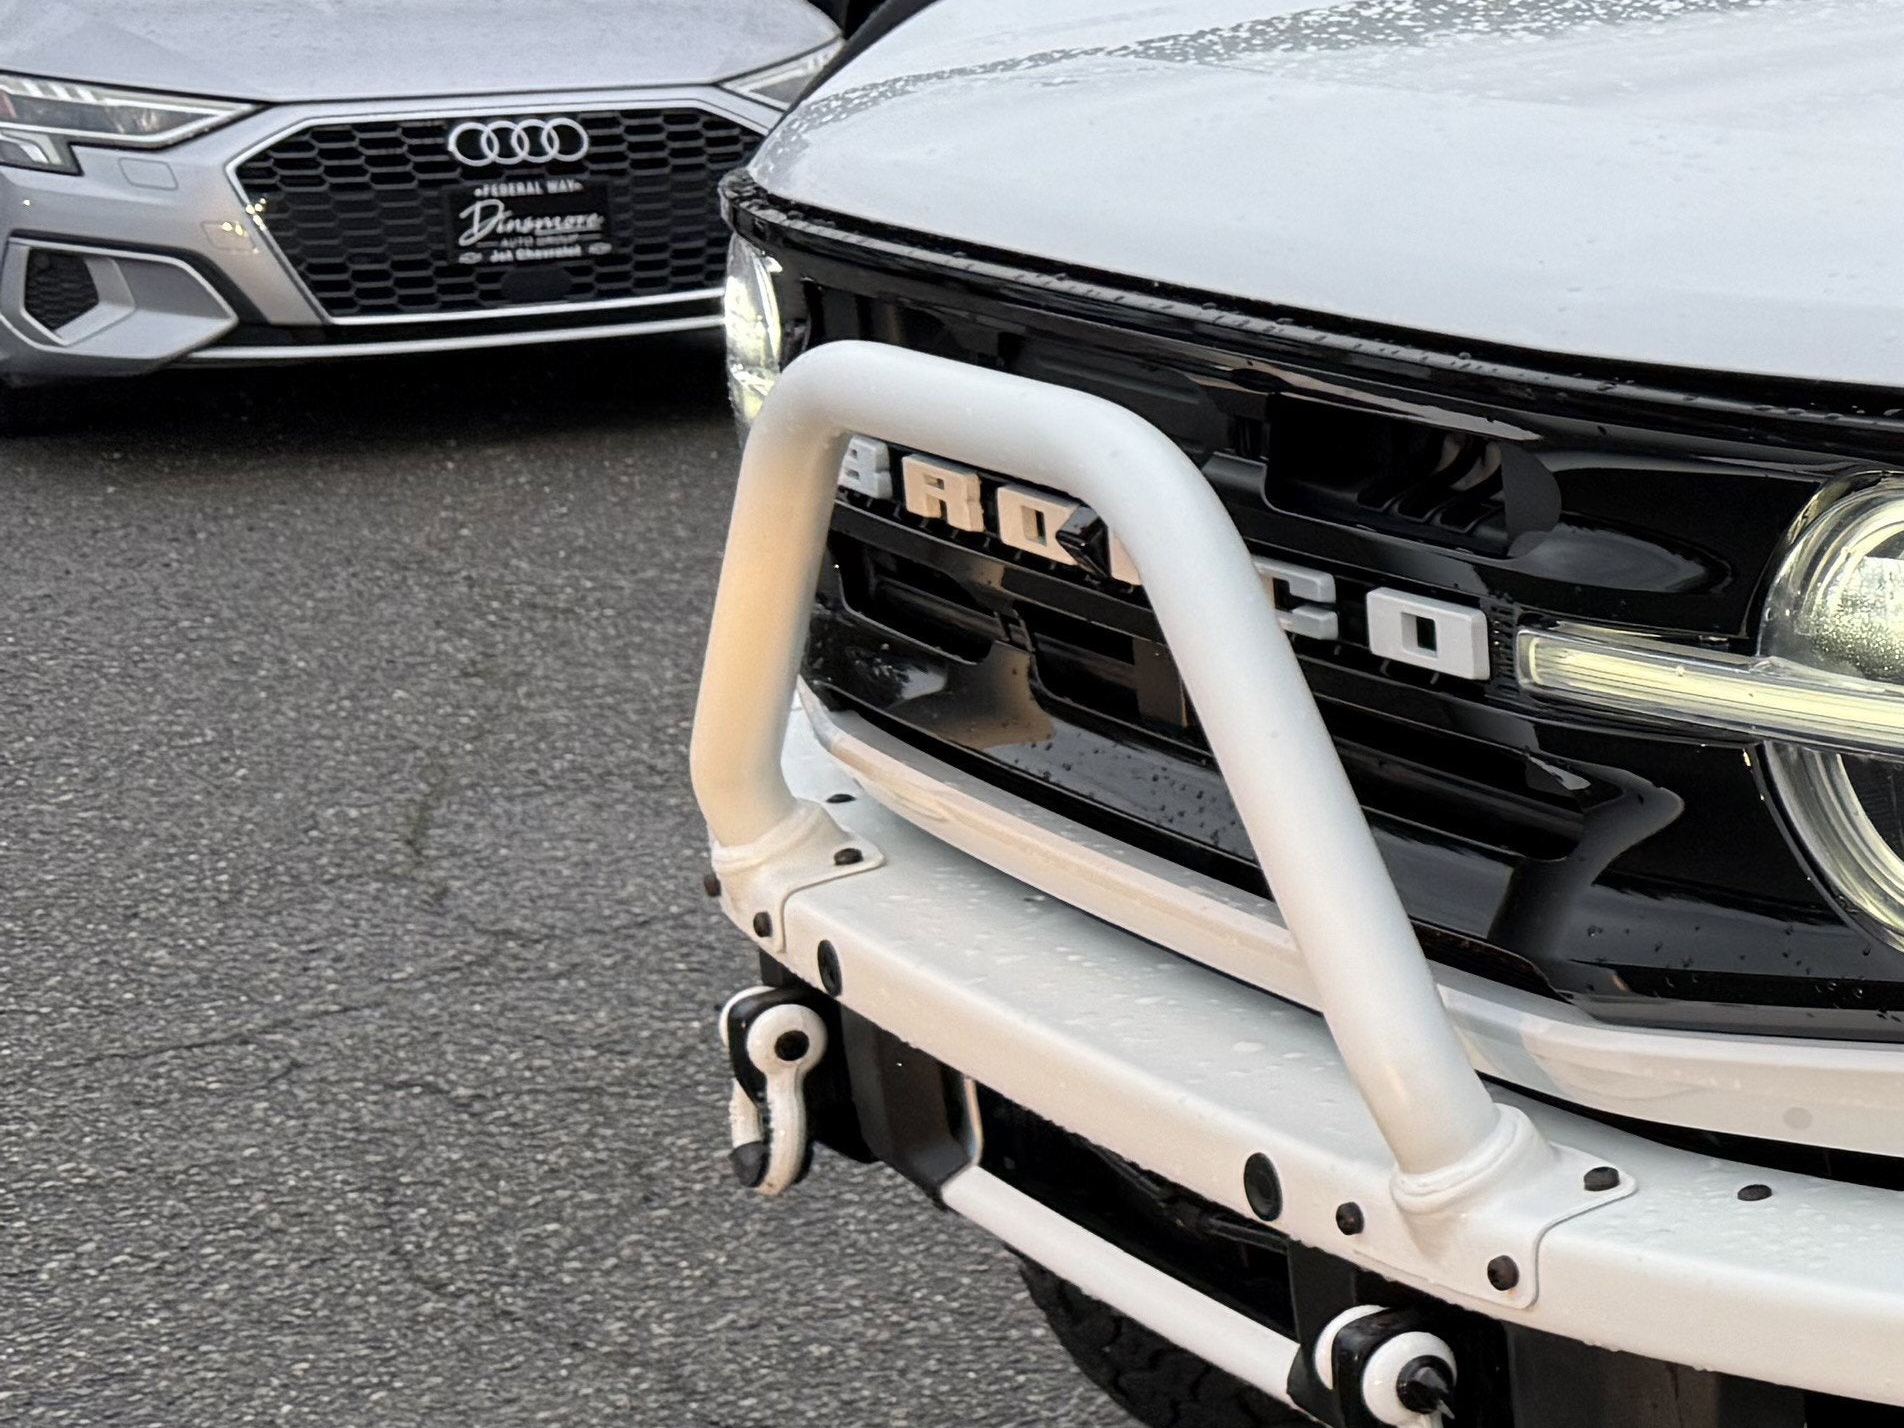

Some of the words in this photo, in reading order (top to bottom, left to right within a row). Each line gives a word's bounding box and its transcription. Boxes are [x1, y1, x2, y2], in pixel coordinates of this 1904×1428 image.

[483, 181, 544, 197] FEDERAL
[546, 178, 574, 194] WAY
[837, 432, 1491, 682] BROCO
